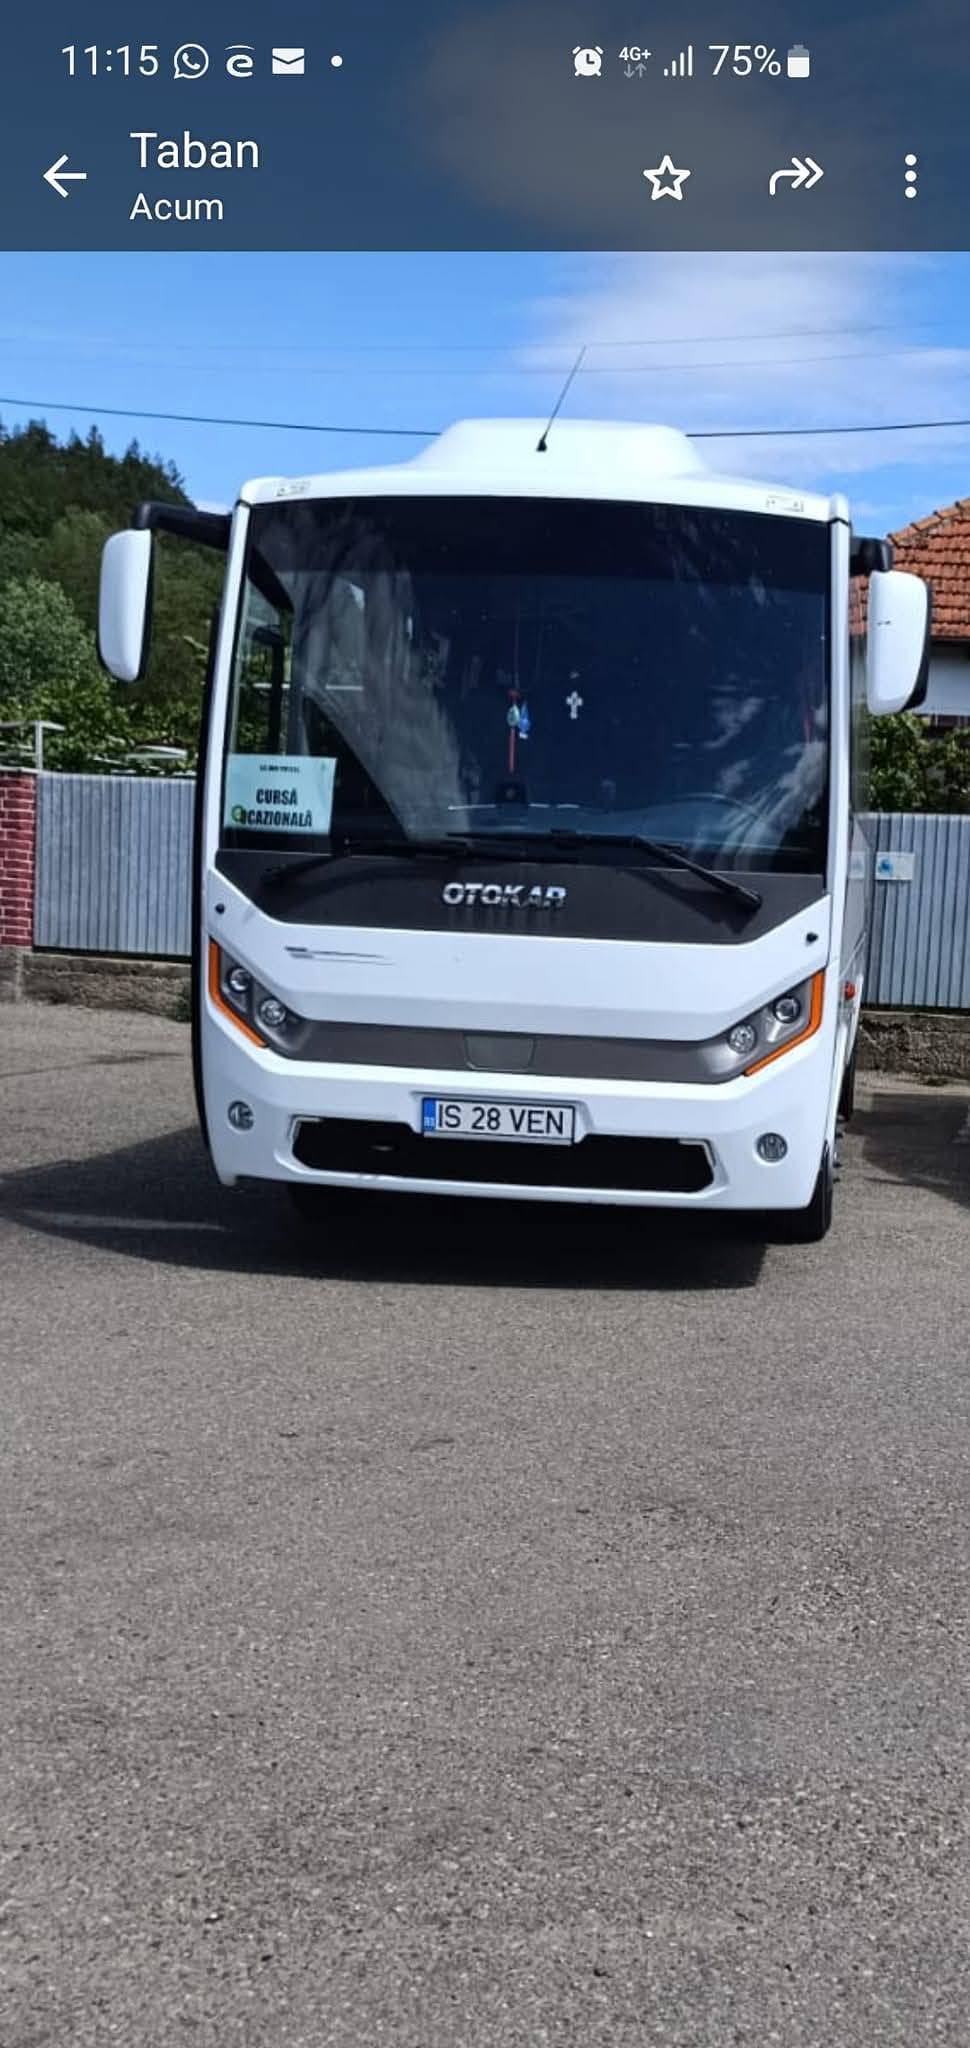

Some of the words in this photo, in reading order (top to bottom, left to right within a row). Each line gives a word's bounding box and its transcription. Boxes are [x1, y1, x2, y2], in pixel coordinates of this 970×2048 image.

[443, 882, 566, 907] OTOKAR
[438, 1103, 461, 1128] IS
[471, 1106, 501, 1131] 28
[509, 1108, 564, 1134] VEN
